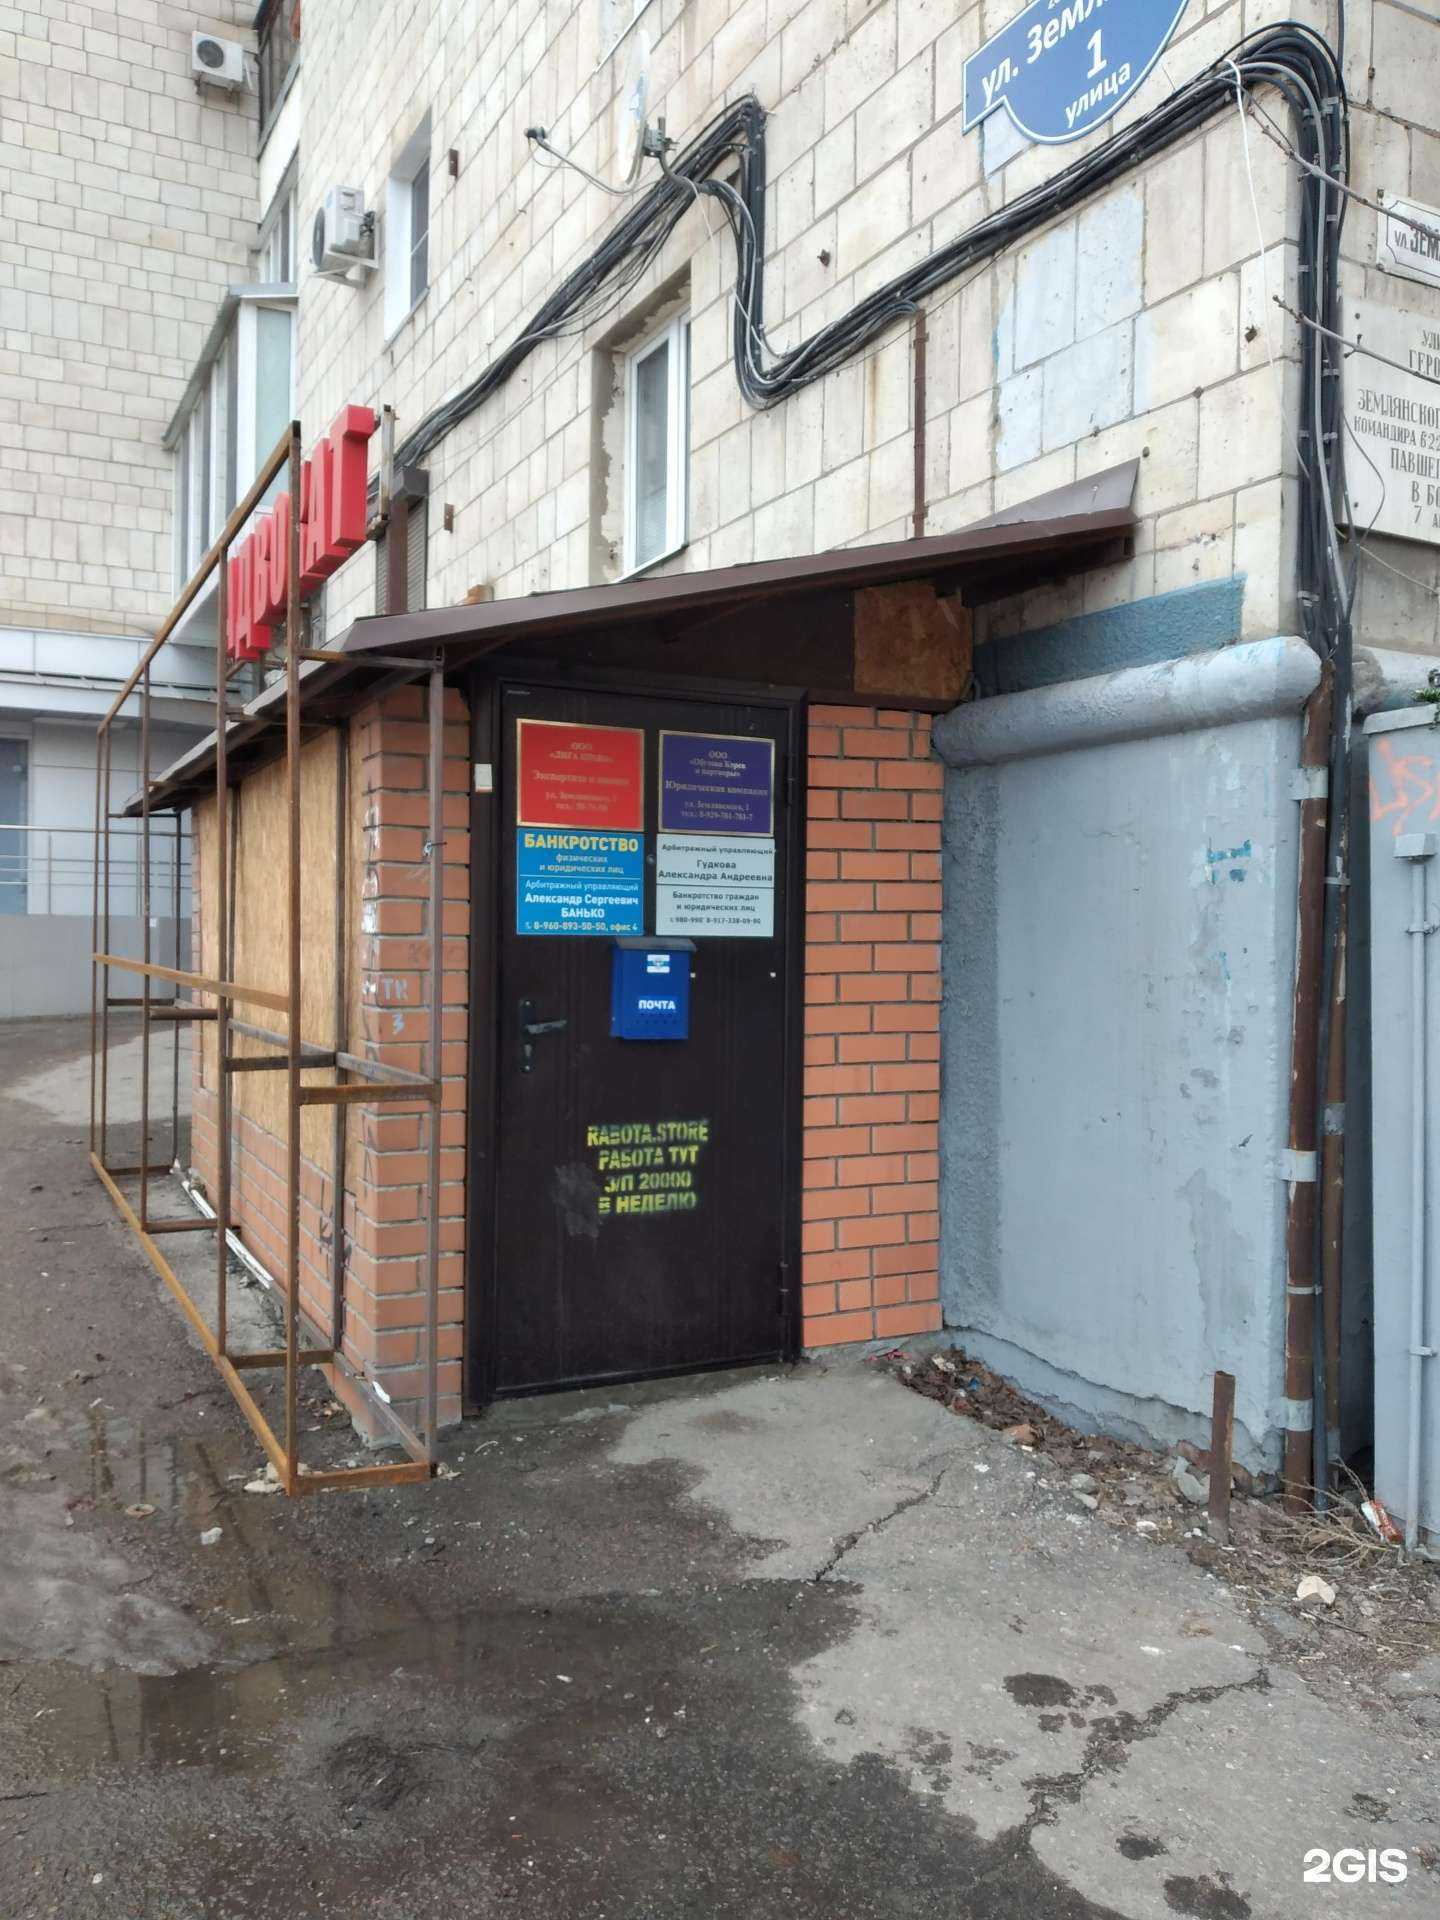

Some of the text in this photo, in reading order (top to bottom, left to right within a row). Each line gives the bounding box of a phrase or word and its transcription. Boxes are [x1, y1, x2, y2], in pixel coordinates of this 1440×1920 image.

[1087, 29, 1107, 78] 1
[982, 57, 1019, 107] ул.
[1065, 62, 1131, 128] улица
[1354, 416, 1416, 445] КОМАНДИРА
[1411, 480, 1420, 502] В
[1413, 505, 1422, 524] 7
[708, 750, 729, 760] ООО
[524, 833, 639, 852] БАНКРОТСТВО
[662, 844, 774, 856] Арбитражный управляющий
[555, 853, 608, 863] физических
[547, 864, 606, 873] юридических
[696, 860, 737, 870] Гудкова
[658, 870, 773, 882] Александра Андреевна
[525, 880, 639, 891] Арбитражный управляющий
[525, 893, 639, 906] Александр Сергеевич
[672, 891, 760, 901] Банкротство граждан
[561, 907, 605, 919] БАНЬКО
[684, 904, 737, 912] юридических
[638, 999, 676, 1010] ПОЧТА
[598, 1145, 699, 1171] РАБОТА ТУТ
[639, 1171, 692, 1190] 20000
[598, 1191, 697, 1215] В НЕДЕЛЮ
